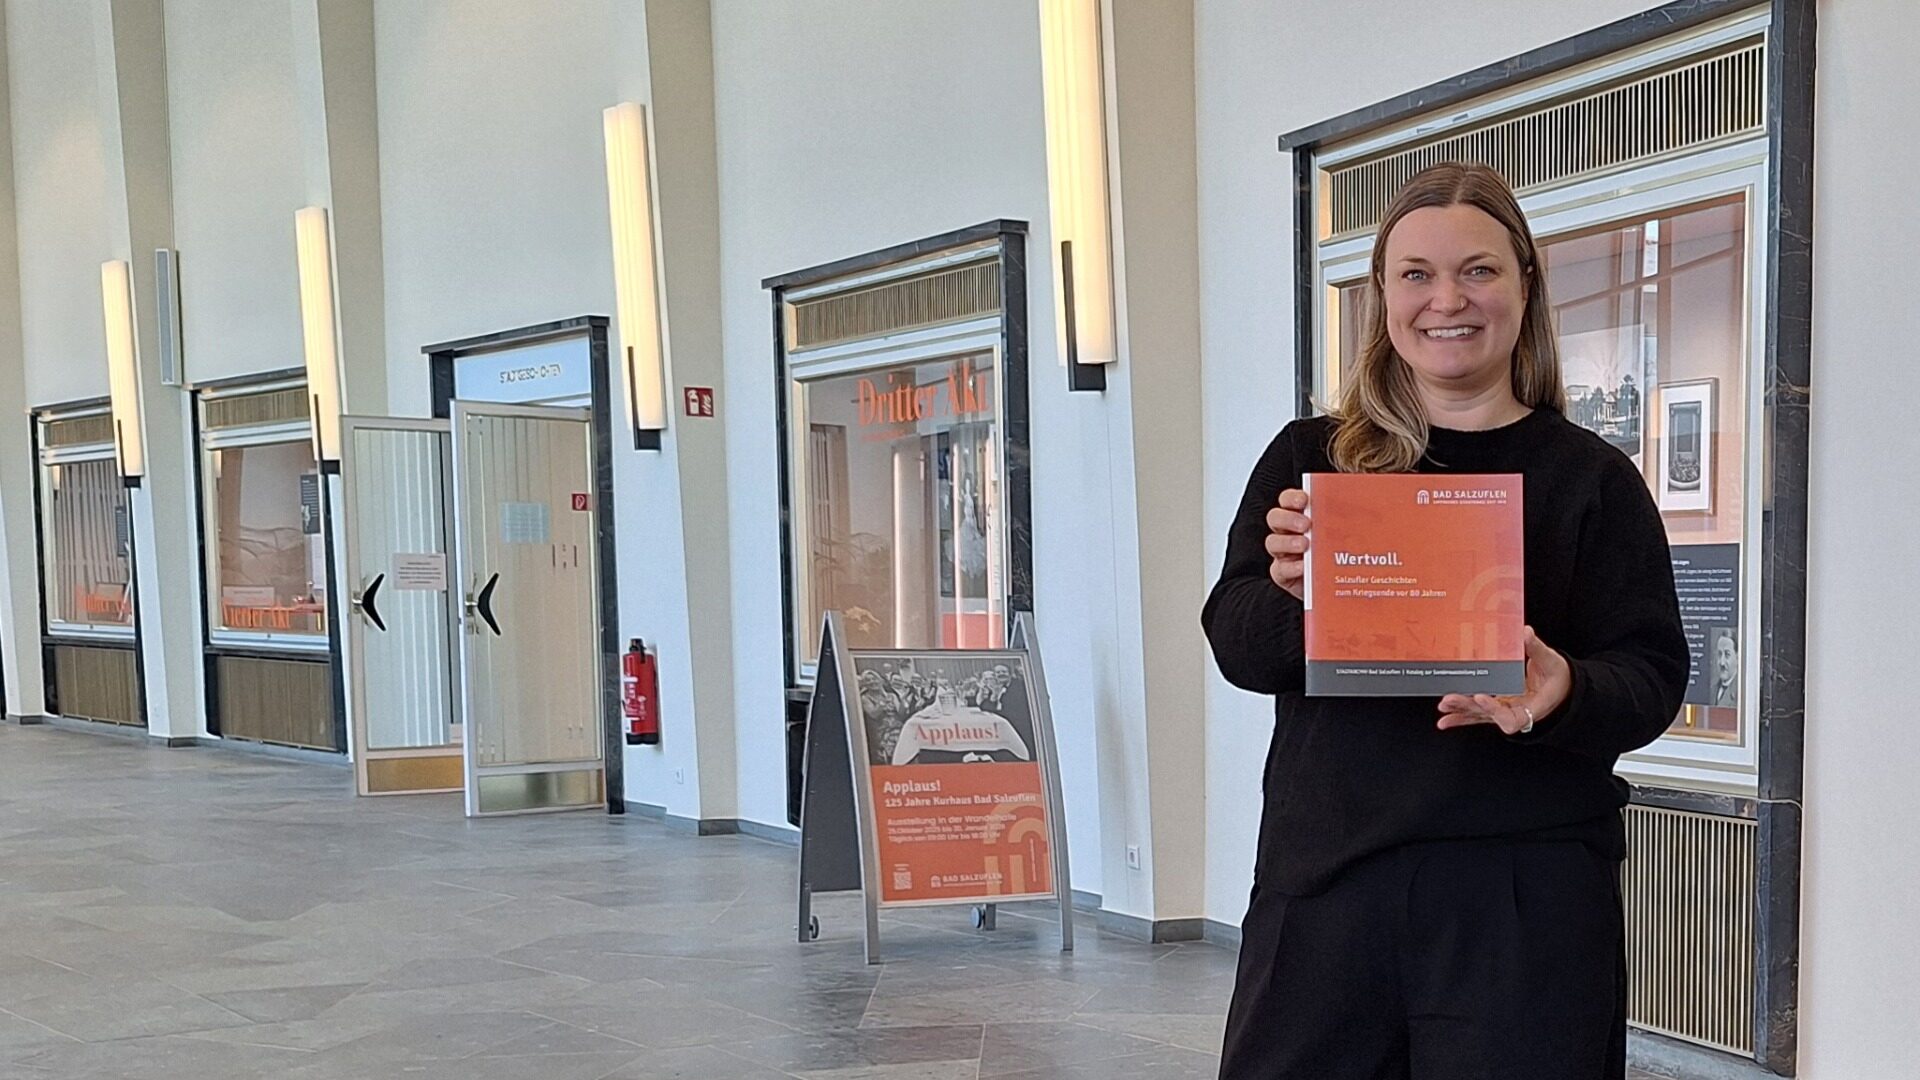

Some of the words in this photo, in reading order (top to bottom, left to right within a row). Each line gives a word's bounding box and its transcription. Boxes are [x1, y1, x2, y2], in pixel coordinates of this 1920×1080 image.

[500, 364, 560, 384] STADTGESCCTEN
[857, 373, 939, 426] Dritter
[944, 361, 991, 415] Akt
[1433, 490, 1452, 498] BAD
[1454, 490, 1507, 498] SALZUFLEN
[1334, 552, 1403, 566] Wertvoll.
[1335, 575, 1368, 584] Salzufler
[1370, 575, 1417, 584] Geschichten
[1352, 588, 1395, 598] Kriegsende
[1397, 589, 1408, 597] vor
[1421, 589, 1447, 598] Jahren
[914, 722, 1000, 746] Applaus!
[883, 780, 941, 795] Applaus!
[885, 797, 902, 808] 125
[904, 796, 931, 807] Jahre
[933, 795, 972, 806] Kurhaus
[973, 794, 992, 804] Bad
[993, 793, 1036, 803] Salzuflen
[937, 814, 947, 824] in
[948, 814, 963, 824] der
[942, 874, 959, 883] BAD
[960, 872, 1003, 881] SALZUFLEN
